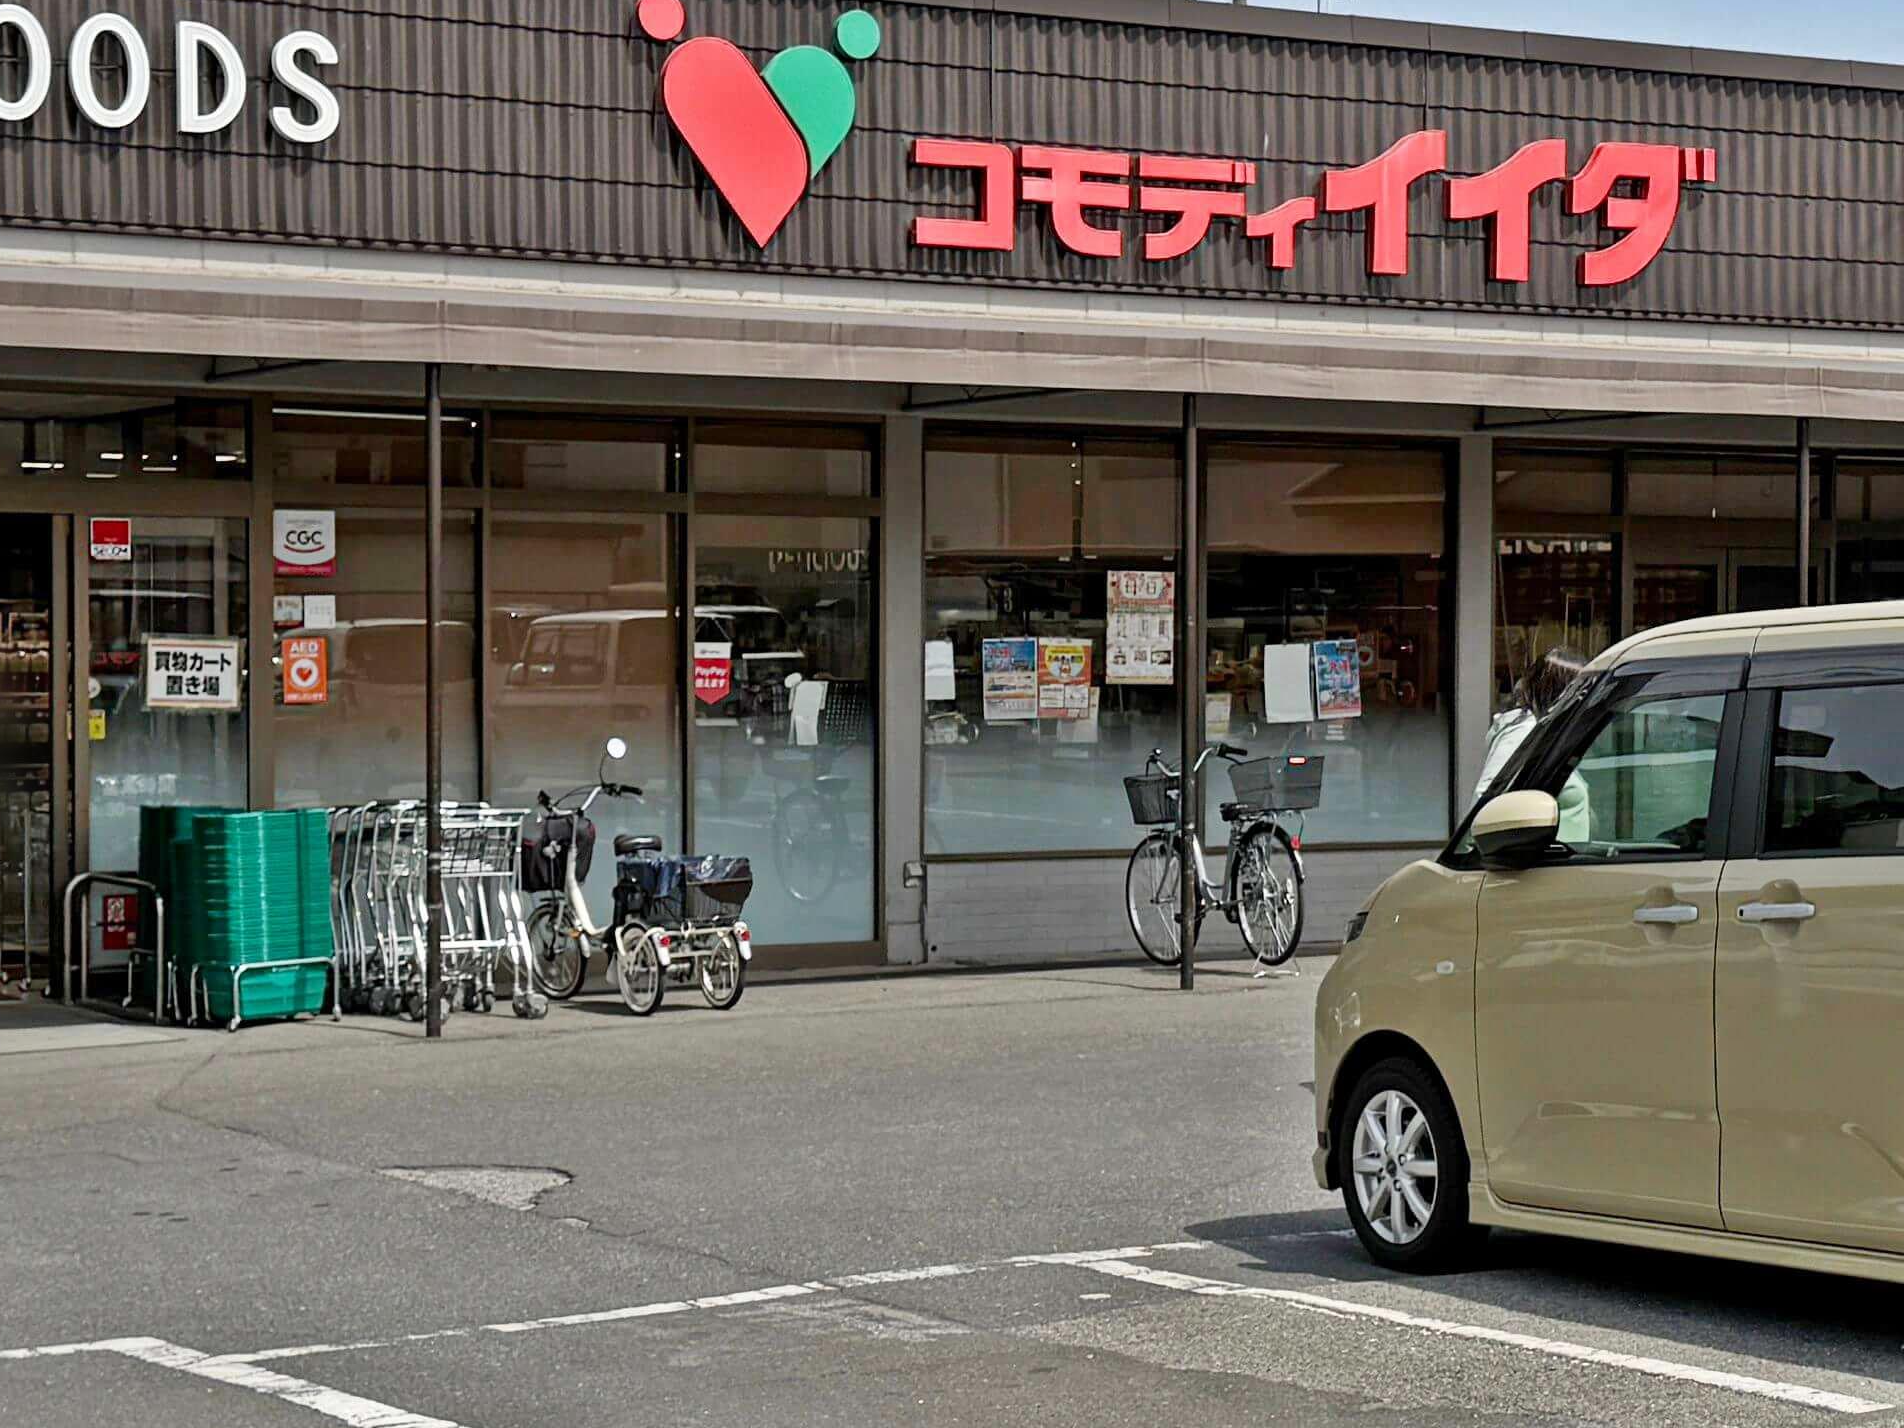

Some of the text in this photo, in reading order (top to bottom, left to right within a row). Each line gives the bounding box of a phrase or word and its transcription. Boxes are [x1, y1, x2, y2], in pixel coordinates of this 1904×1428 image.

[911, 128, 1716, 286] コモディイイダ
[285, 530, 324, 546] CGC
[290, 641, 319, 653] AED
[154, 651, 232, 673] 買物カート
[165, 675, 220, 697] 置き場
